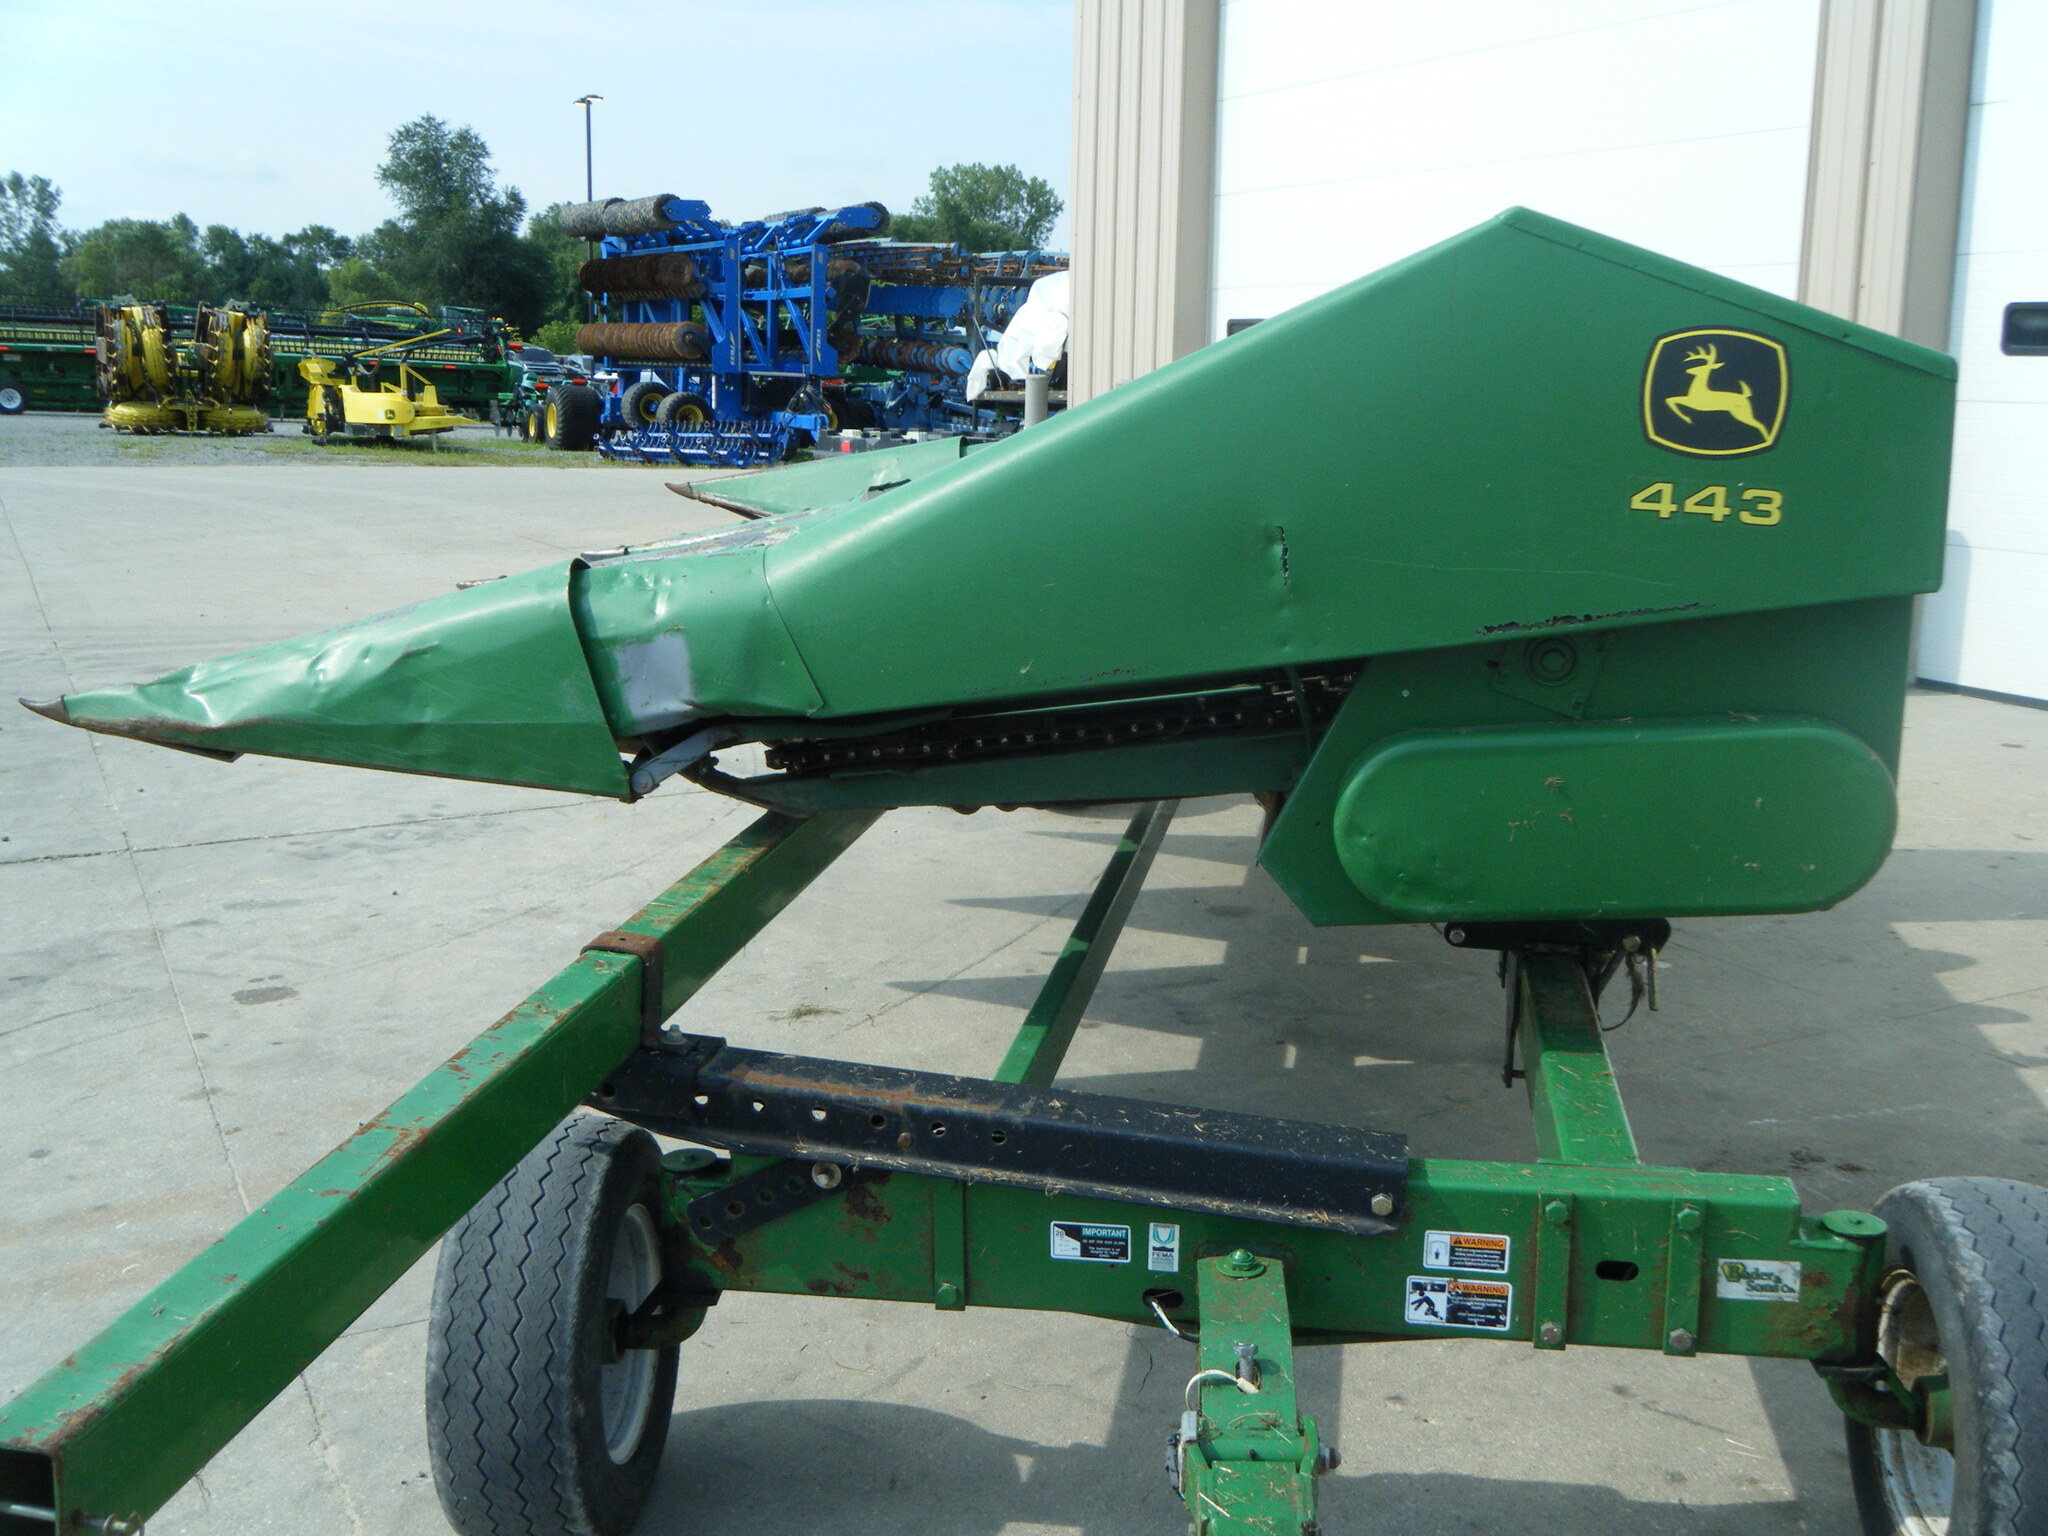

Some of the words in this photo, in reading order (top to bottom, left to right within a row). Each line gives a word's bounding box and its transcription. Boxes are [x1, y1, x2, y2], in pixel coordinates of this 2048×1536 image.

[1630, 482, 1783, 526] 443
[1082, 1227, 1127, 1238] IMPORTANT
[1463, 1237, 1504, 1248] WARNING
[1462, 1283, 1506, 1294] WARNING
[1746, 1279, 1779, 1293] Sons
